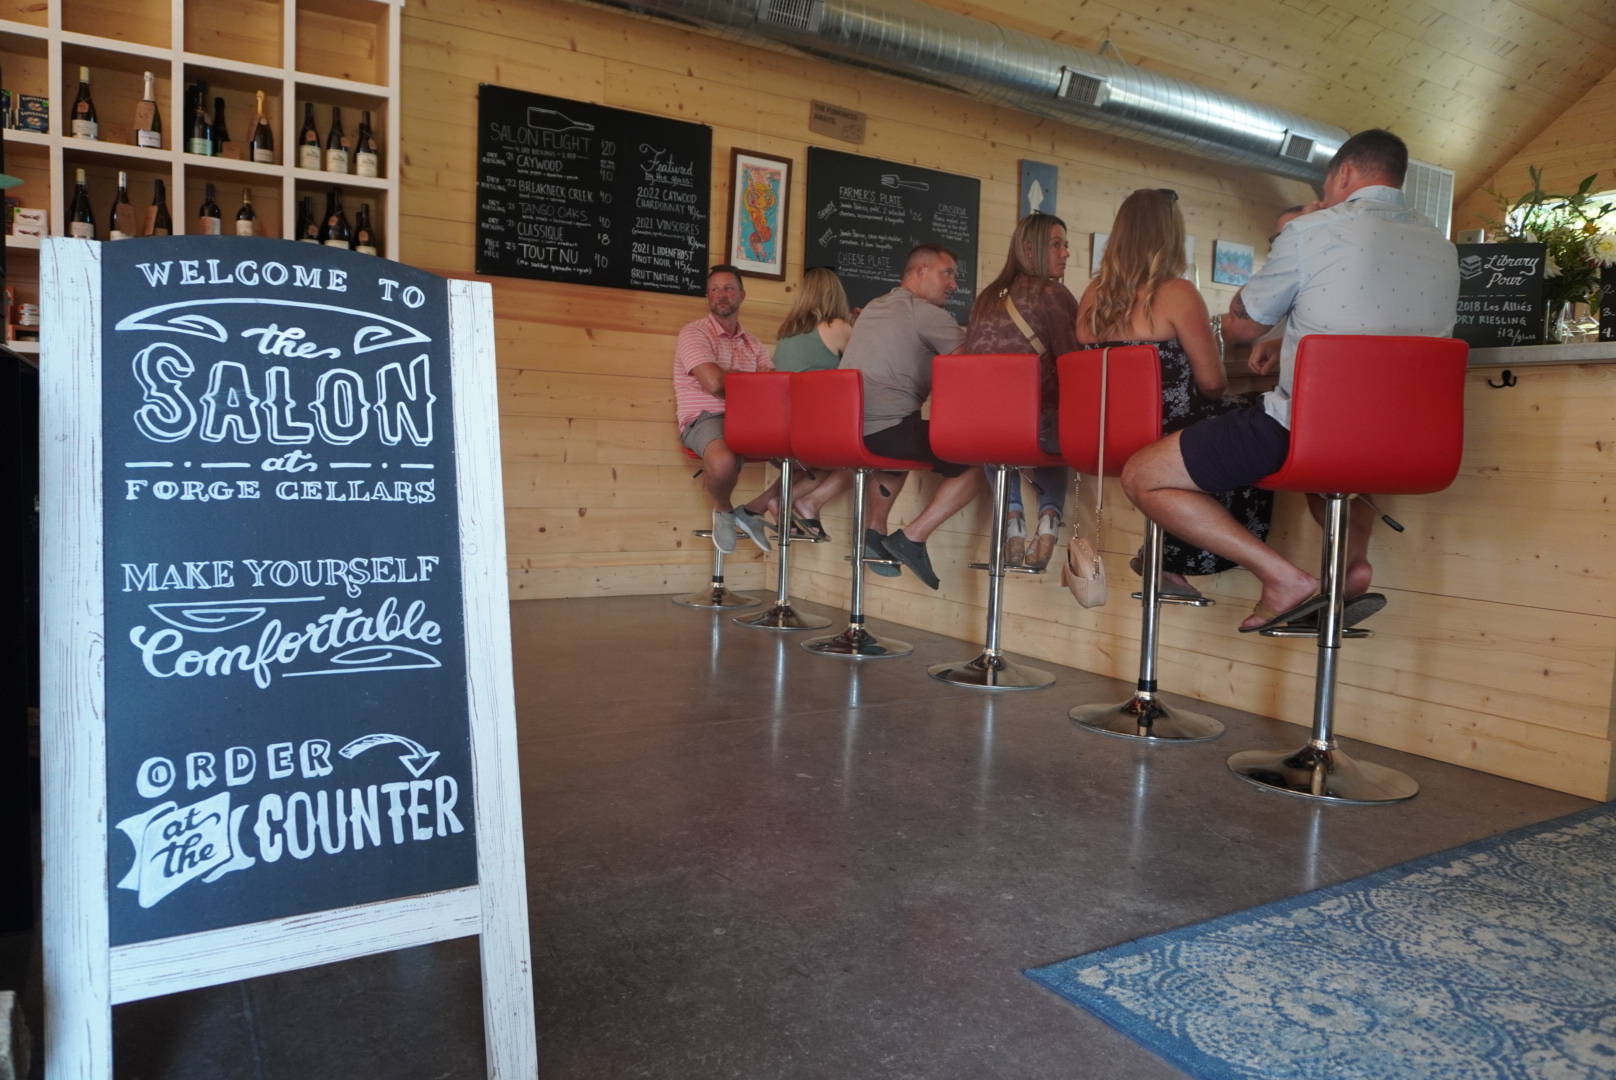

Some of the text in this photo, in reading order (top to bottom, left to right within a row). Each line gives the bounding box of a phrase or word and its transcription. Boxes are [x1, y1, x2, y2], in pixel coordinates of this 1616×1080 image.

[814, 104, 825, 112] THE
[490, 122, 592, 152] SALON FLIGHT
[482, 157, 506, 166] RIESLING
[516, 154, 564, 172] CAYWOOD
[639, 143, 694, 176] Featured
[481, 182, 506, 192] RIESLING
[486, 176, 500, 184] DRY
[505, 178, 517, 188] '22
[645, 171, 693, 187] by the glass:
[518, 180, 594, 203] BREAKNECK CREEK
[637, 186, 697, 204] 2022 CAYWOOD
[840, 186, 902, 206] FARMER'S PLATE
[482, 204, 506, 214] RIESLING
[518, 202, 588, 222] TANGO OAKS
[636, 197, 684, 215] CHARDONNAY
[817, 200, 836, 220] GRANDE
[883, 206, 888, 214] 2
[938, 202, 966, 217] CONSERVA
[482, 222, 506, 232] RIESLING
[488, 217, 500, 225] DRY
[635, 216, 700, 236] 2021 VINSOBRES
[516, 222, 564, 242] CLASSIQUE
[597, 232, 610, 246] $8
[818, 227, 834, 246] PETITE
[504, 242, 516, 252] '23
[518, 243, 579, 264] TOUT NU
[632, 242, 650, 254] 2021
[594, 253, 608, 268] $10
[632, 253, 652, 264] PINOT
[653, 256, 672, 268] NOIR
[838, 252, 891, 268] CHEESE PLATE
[1483, 254, 1540, 276] Library
[135, 258, 426, 309] WELCOME TO
[631, 268, 652, 280] BRUT
[653, 271, 680, 284] NATURE
[1484, 272, 1526, 288] Pour
[1456, 300, 1532, 312] 2018 Les Alliés
[1455, 315, 1527, 326] DRY RIESLING
[241, 322, 341, 360] the
[1496, 328, 1536, 346] $12/glass
[132, 342, 437, 447] SALON
[261, 449, 318, 472] at
[125, 478, 436, 504] FORGE CELLARS
[120, 556, 440, 598] MAKE YOURSELF
[129, 596, 442, 689] Comfortable
[136, 738, 334, 799] ORDER
[163, 808, 222, 841] at
[253, 774, 465, 863] COUNTER
[150, 832, 217, 878] the
